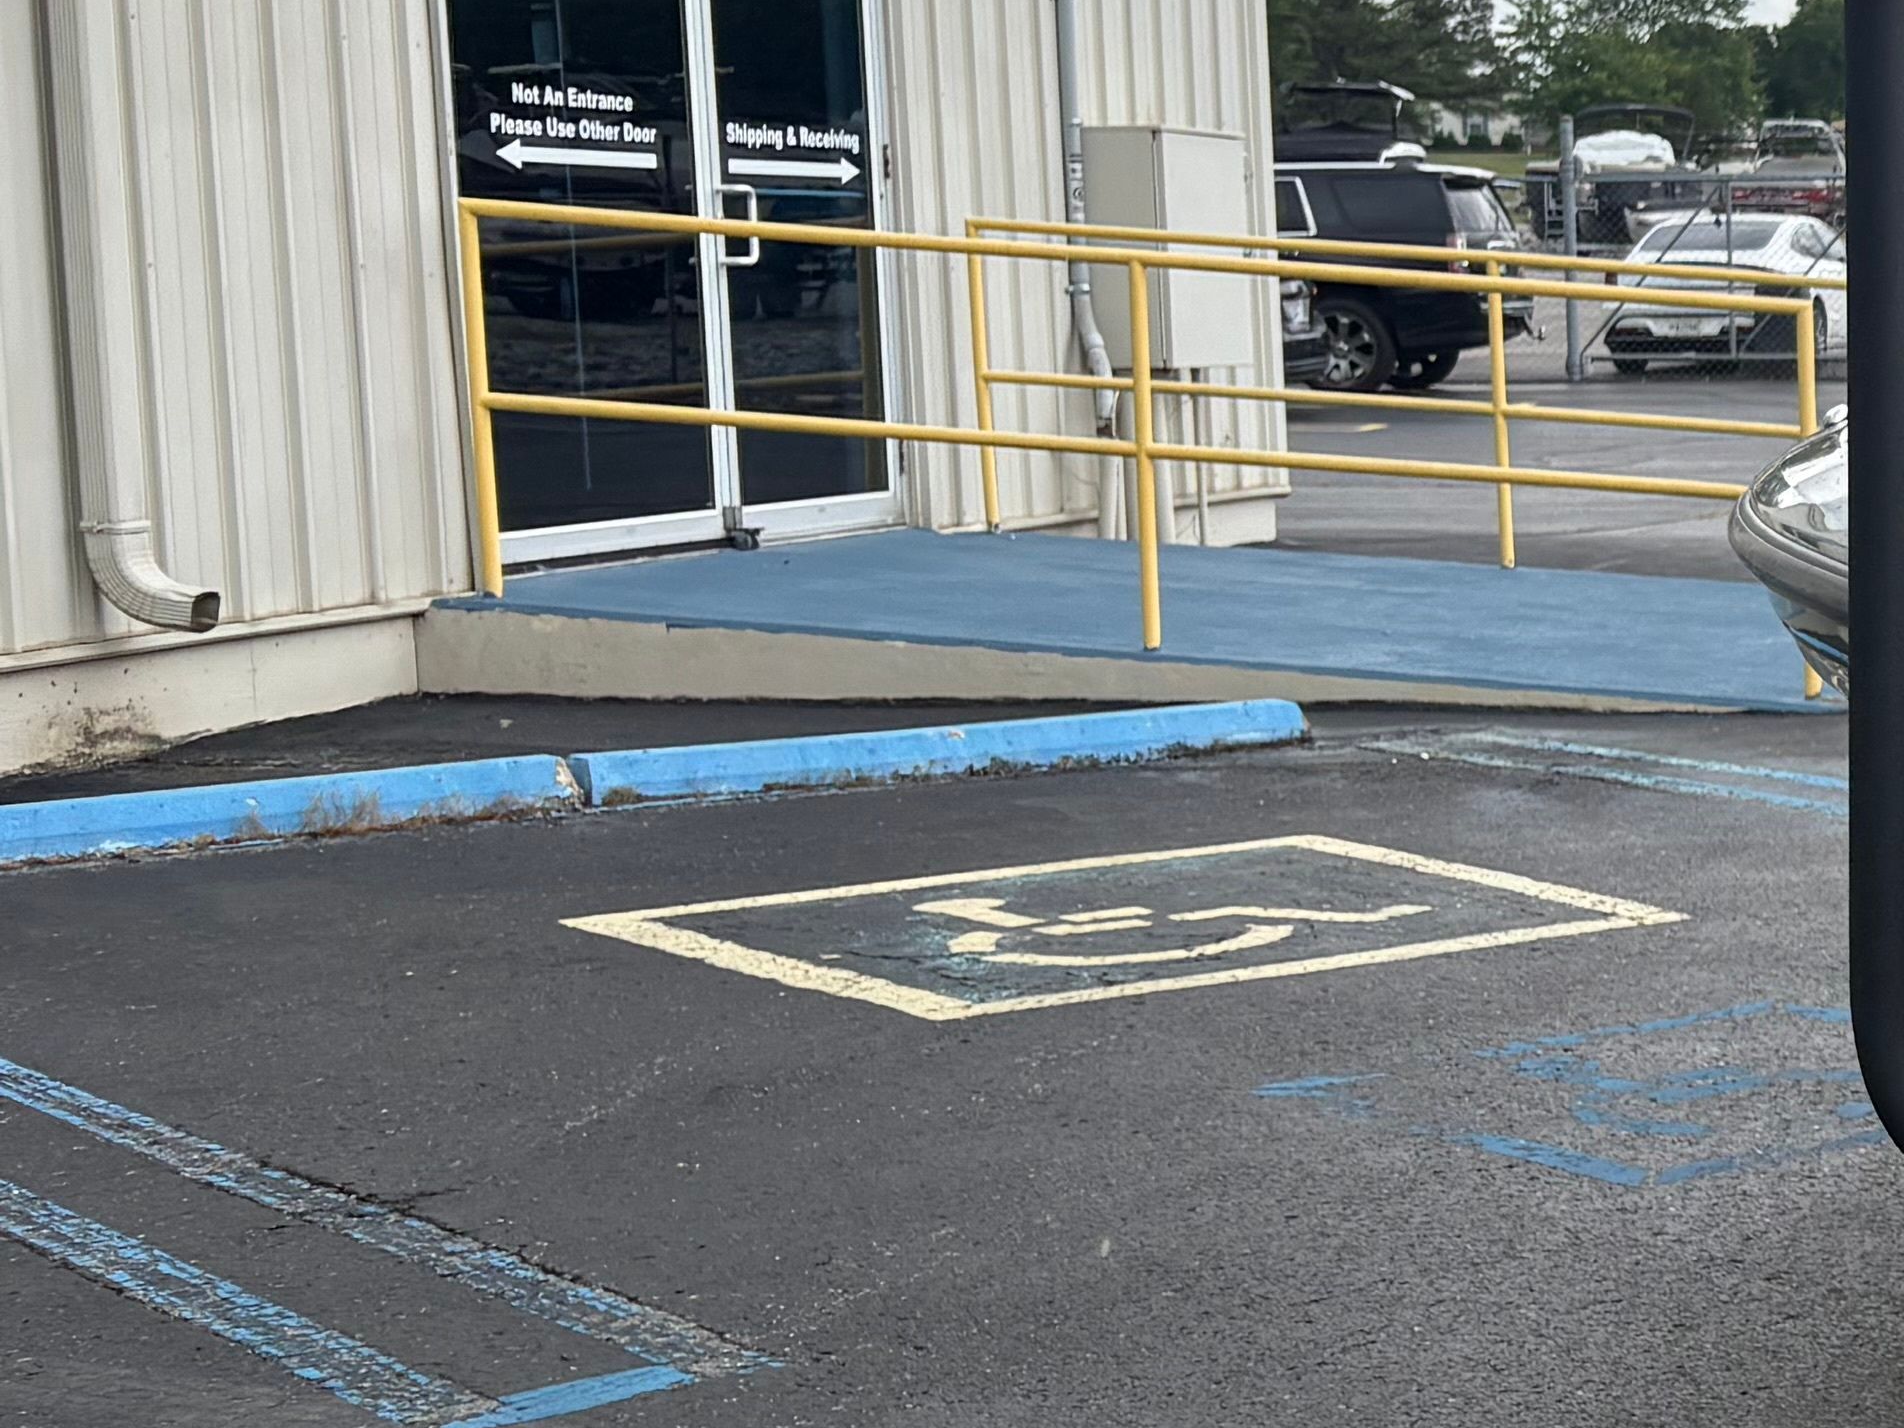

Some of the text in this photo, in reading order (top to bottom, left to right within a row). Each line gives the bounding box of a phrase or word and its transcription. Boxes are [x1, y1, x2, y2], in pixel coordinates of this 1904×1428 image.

[511, 82, 634, 112] Not An Entrance
[489, 112, 657, 144] Please Use Other Door
[725, 122, 860, 155] Shipping & Receiving
